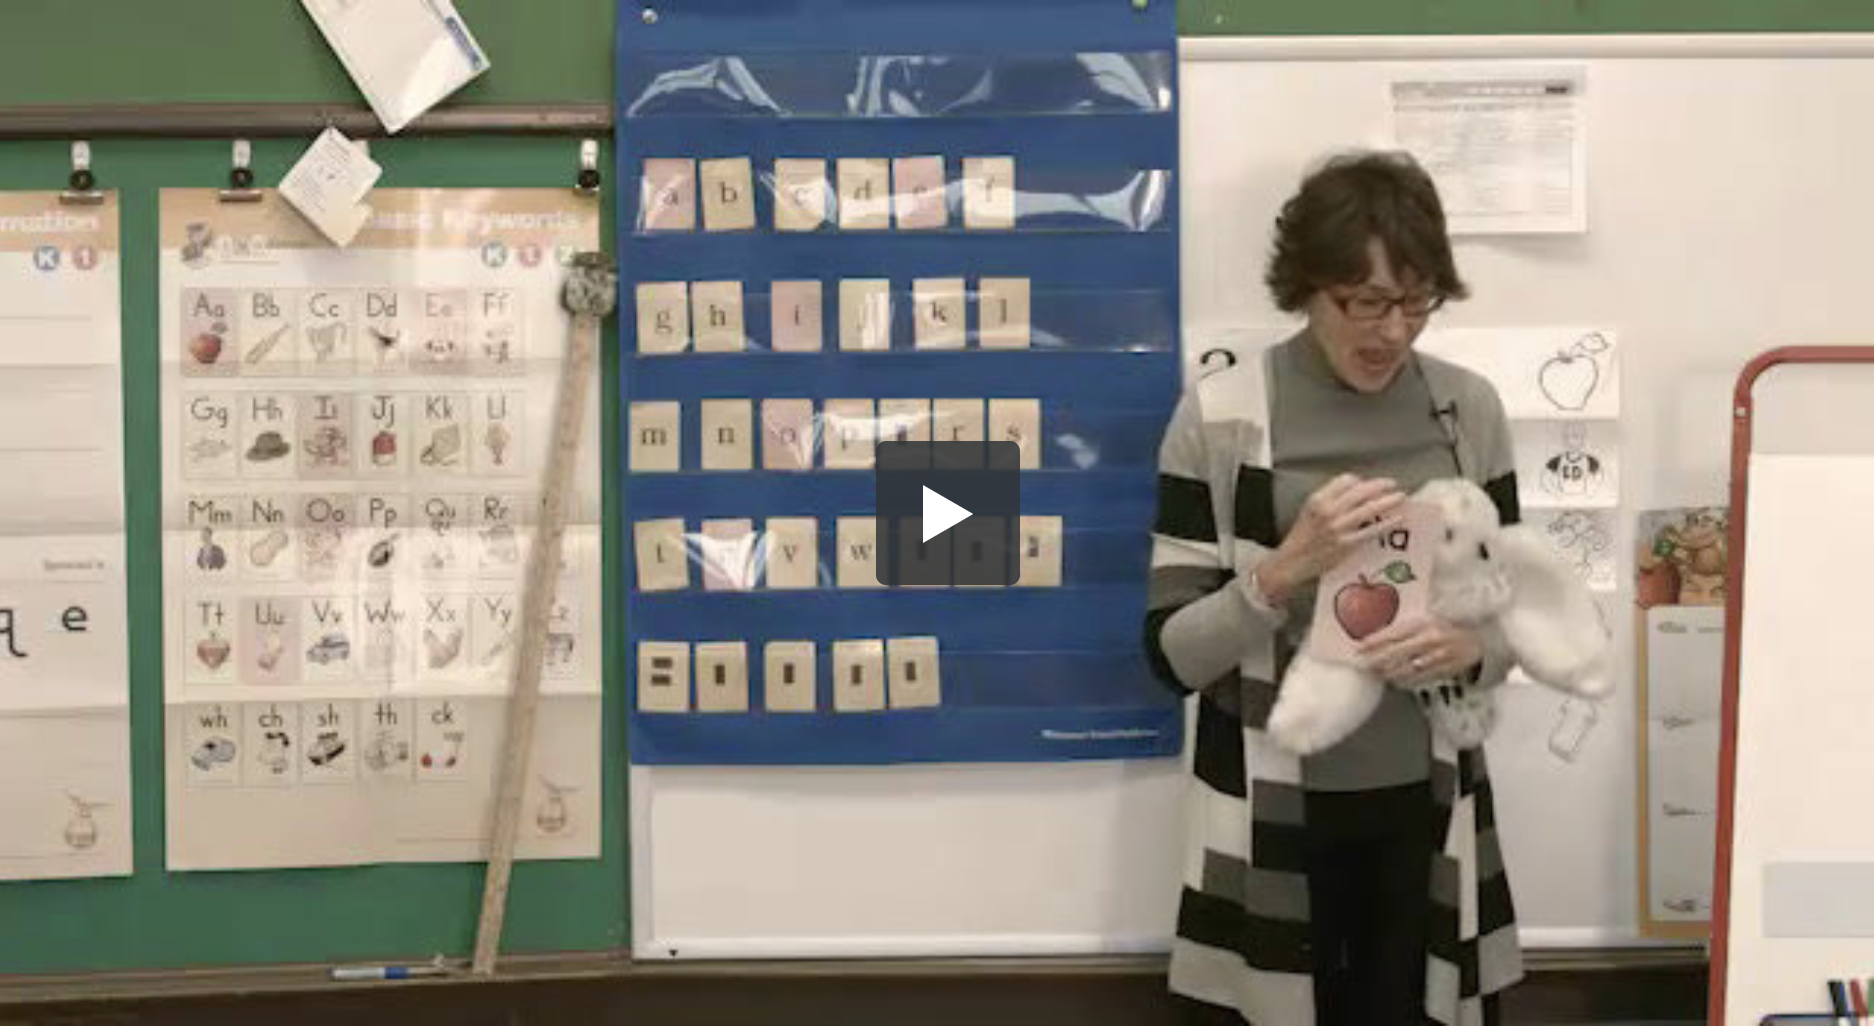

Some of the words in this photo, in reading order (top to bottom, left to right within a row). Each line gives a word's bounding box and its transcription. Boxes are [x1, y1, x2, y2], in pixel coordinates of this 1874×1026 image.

[718, 180, 739, 205] b
[853, 179, 873, 201] d
[193, 293, 225, 317] Aa
[252, 293, 281, 317] Bb
[310, 292, 339, 317] Cc
[366, 292, 397, 317] Dd
[425, 292, 453, 317] Ee
[483, 292, 508, 317] Ff
[655, 308, 673, 335] g
[708, 302, 727, 327] h
[929, 299, 949, 324] k
[190, 397, 228, 428] Gg
[252, 397, 282, 421] Hh
[314, 395, 339, 420] Ii
[371, 395, 395, 428] Jj
[425, 395, 453, 419] Kk
[487, 395, 507, 420] Ll
[640, 427, 668, 447] m
[717, 426, 736, 447] n
[188, 500, 233, 524] Mm
[252, 498, 285, 523] Nn
[306, 498, 346, 523] Oo
[370, 498, 398, 528] Pp
[484, 497, 509, 520] Rr
[782, 543, 798, 564] v
[849, 542, 875, 563] w
[61, 605, 88, 632] e
[197, 602, 225, 626] Tt
[255, 601, 285, 625] Uu
[312, 600, 343, 623] Vv
[364, 599, 406, 623] Ww
[425, 599, 457, 622] Xx
[485, 598, 513, 628] Yy
[199, 703, 228, 728] wh
[258, 702, 284, 727] ch
[316, 702, 339, 726] sh
[373, 702, 398, 725] th
[430, 701, 454, 724] ck
